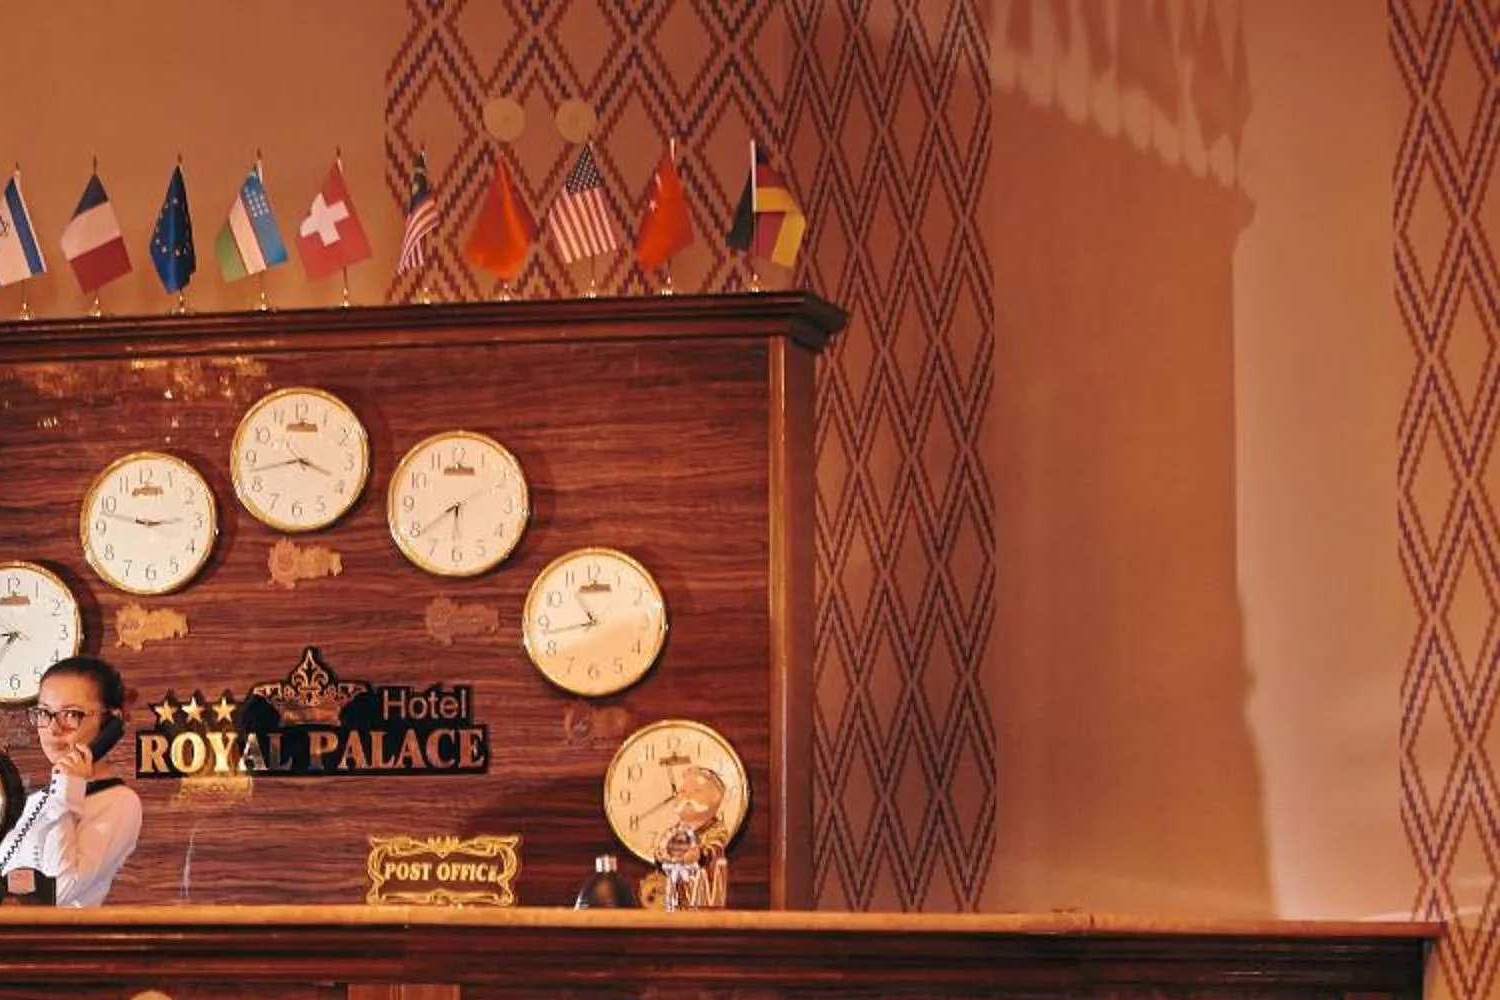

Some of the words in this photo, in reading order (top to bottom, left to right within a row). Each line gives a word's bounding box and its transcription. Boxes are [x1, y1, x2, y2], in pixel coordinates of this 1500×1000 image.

[273, 409, 285, 423] 11
[295, 402, 309, 420] 12
[256, 427, 270, 443] 10
[246, 450, 257, 465] 9
[344, 455, 355, 471] 3
[432, 453, 441, 470] 11
[139, 467, 153, 483] 12
[119, 475, 129, 492] 11
[252, 479, 263, 493] 8
[101, 495, 117, 513] 10
[184, 489, 194, 504] 2
[269, 493, 280, 510] 7
[403, 497, 415, 512] 9
[292, 501, 304, 517] 6
[95, 520, 107, 536] 9
[195, 514, 203, 529] 3
[409, 521, 421, 539] 8
[104, 544, 114, 561] 8
[186, 539, 196, 553] 4
[429, 539, 438, 557] 7
[452, 546, 462, 562] 6
[476, 540, 486, 556] 5
[124, 560, 133, 576] 7
[145, 564, 157, 581] 6
[170, 558, 179, 575] 5
[587, 564, 601, 580] 12
[8, 577, 20, 594] 12
[565, 571, 575, 587] 11
[51, 598, 61, 617] 2
[546, 591, 563, 608] 10
[60, 624, 68, 640] 3
[538, 615, 549, 633] 9
[546, 640, 557, 656] 8
[632, 639, 641, 655] 4
[50, 649, 59, 663] 4
[566, 656, 575, 674] 7
[588, 662, 599, 680] 6
[614, 657, 623, 674] 5
[10, 674, 20, 690] 6
[383, 689, 467, 720] Hotel
[139, 732, 292, 772] ROYAL
[307, 729, 486, 770] PALACE
[646, 743, 655, 759] 11
[385, 863, 432, 880] POST
[436, 863, 498, 882] OFFICE
